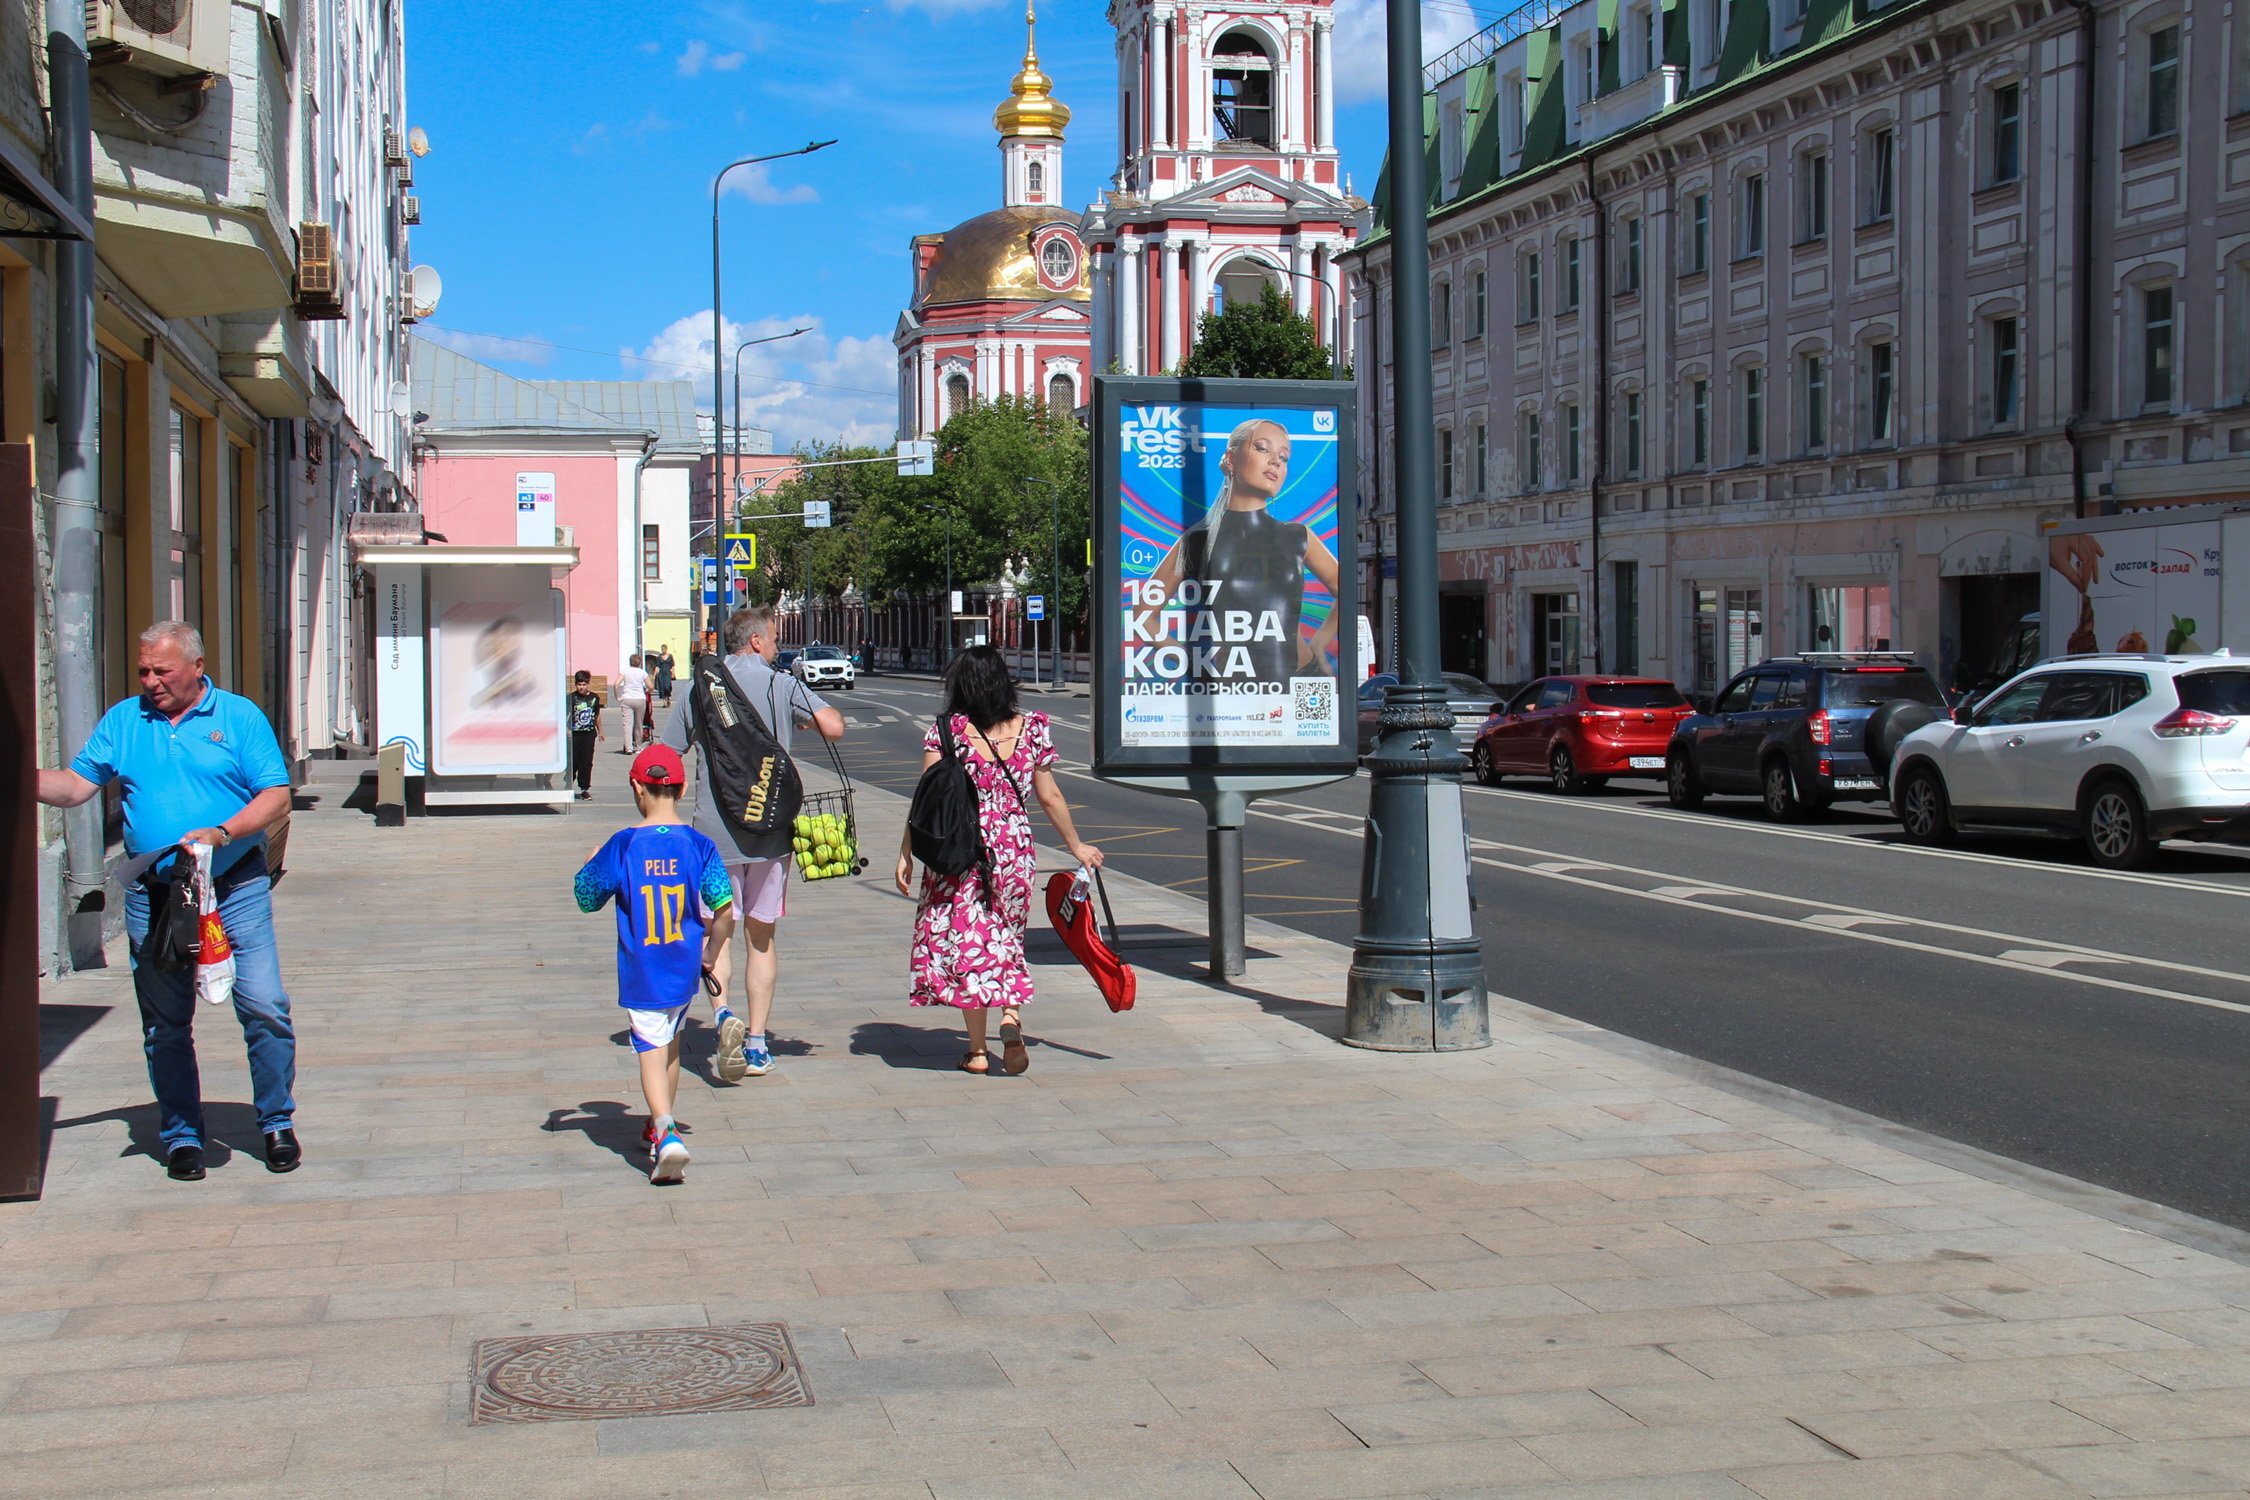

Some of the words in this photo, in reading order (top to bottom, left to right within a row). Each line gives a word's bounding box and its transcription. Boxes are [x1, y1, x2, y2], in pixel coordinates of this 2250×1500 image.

[1137, 407, 1187, 429] VK
[1316, 416, 1330, 426] VK
[1121, 421, 1207, 453] fest
[1138, 454, 1186, 468] 2023
[1131, 549, 1153, 564] 0+
[2115, 561, 2148, 572] ВОСТОК
[2161, 563, 2191, 574] ЗАПАД
[391, 583, 400, 621] Баумана
[1123, 579, 1223, 606] 16.07
[391, 623, 399, 651] имени
[1124, 610, 1287, 642] КЛАВА
[391, 653, 400, 670] Сад
[1124, 646, 1257, 678] КОКА
[1124, 682, 1175, 696] ПАРК
[1181, 682, 1283, 696] ГОРЬКОГО
[744, 755, 775, 823] Wilson
[645, 859, 678, 876] PELE
[640, 884, 685, 946] 10
